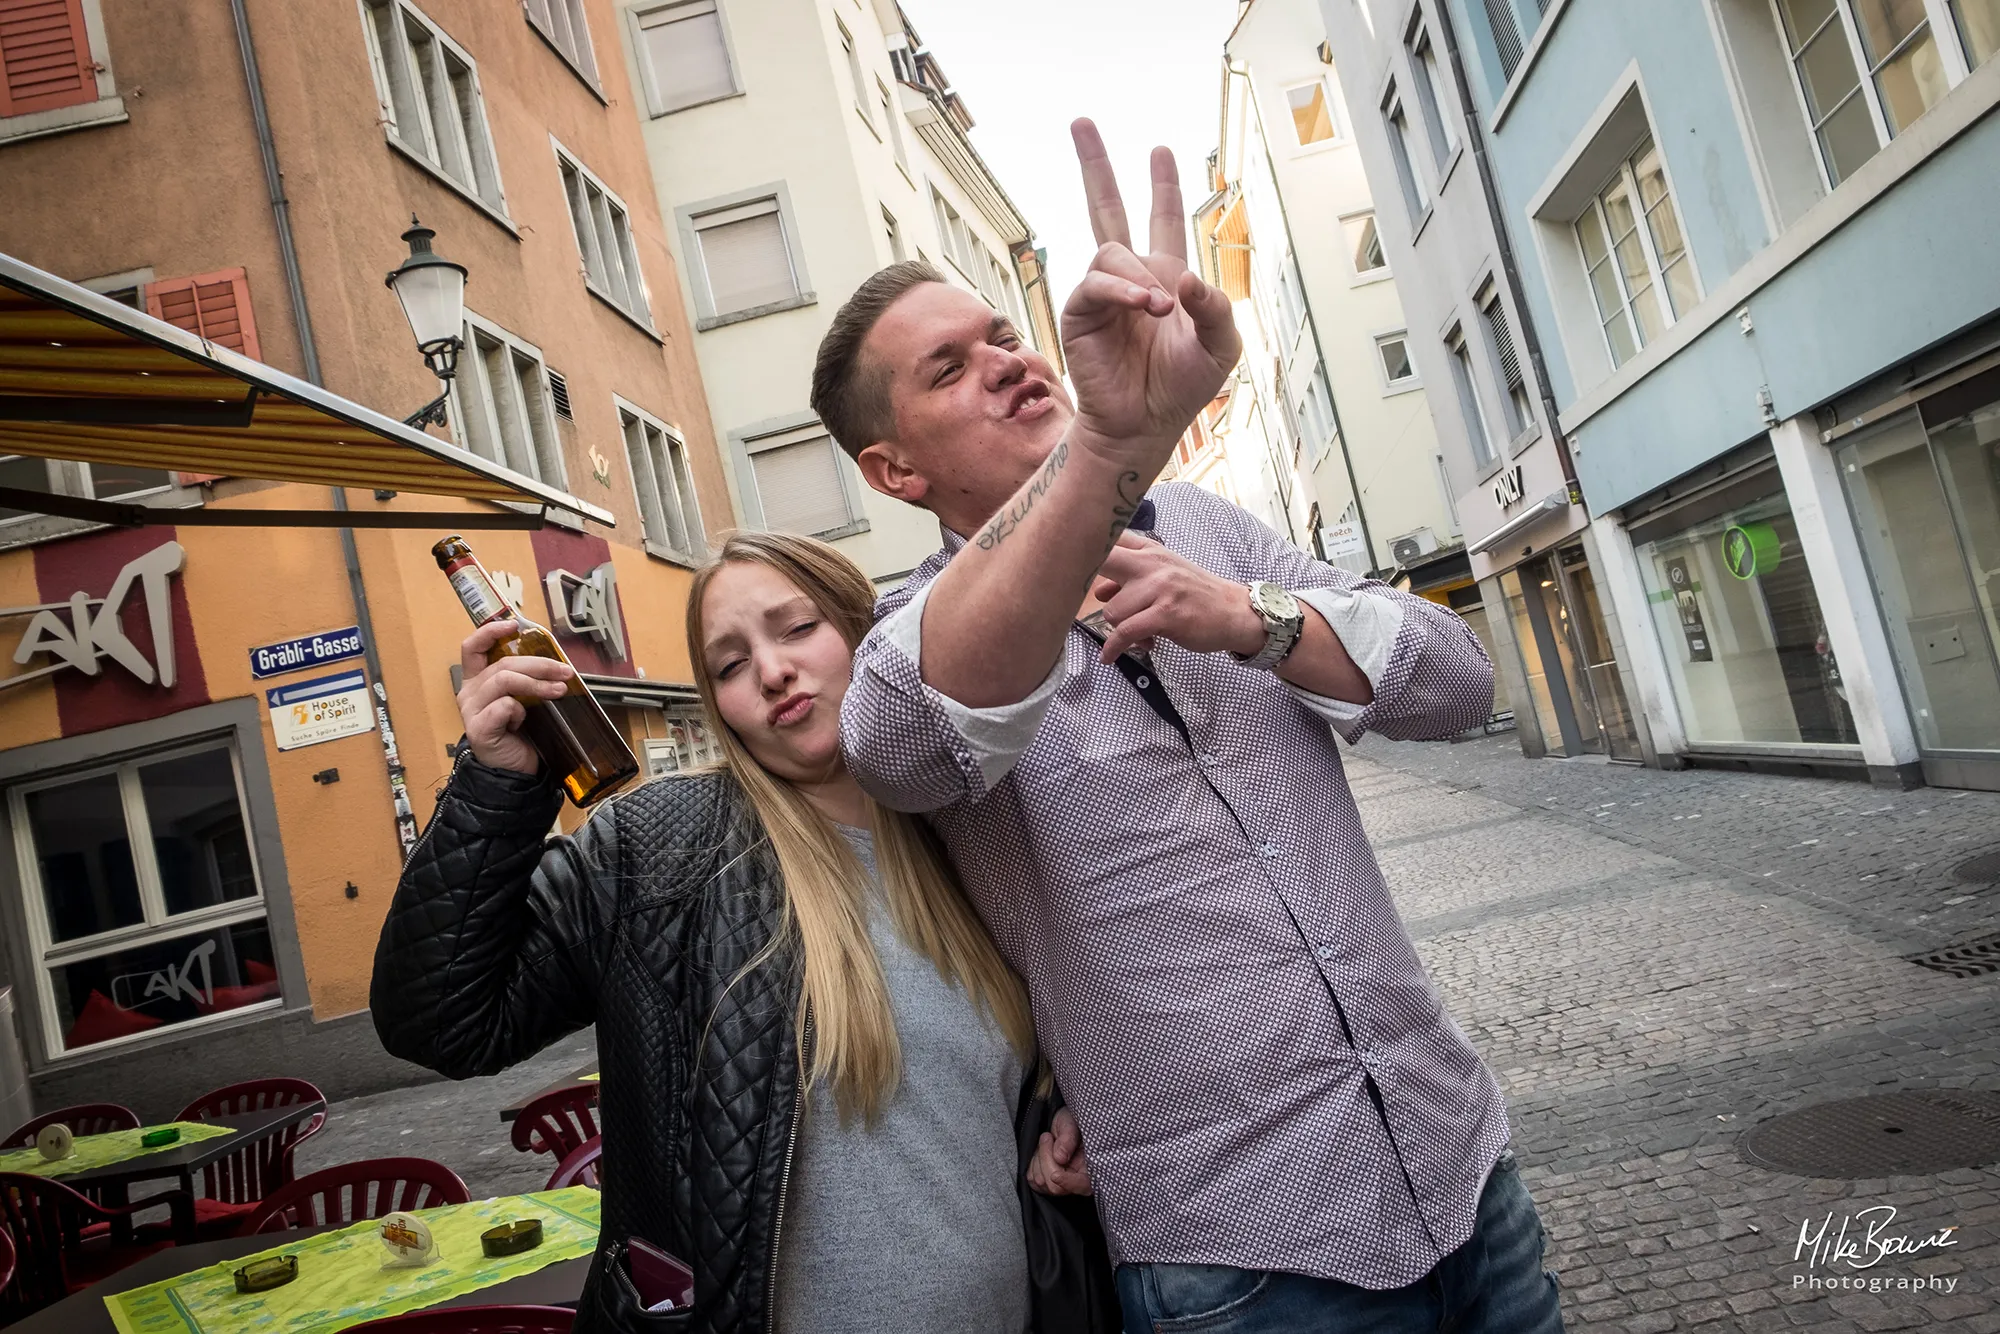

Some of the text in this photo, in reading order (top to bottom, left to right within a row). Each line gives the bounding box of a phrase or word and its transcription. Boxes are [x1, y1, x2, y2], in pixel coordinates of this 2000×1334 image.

[1493, 465, 1525, 510] ONLY
[13, 540, 187, 688] AKT
[258, 635, 360, 670] Gräbli-Gasse
[311, 697, 349, 712] House
[314, 704, 356, 721] of Spirit
[291, 732, 312, 742] Suche
[340, 722, 359, 733] Finde
[144, 939, 216, 1005] AKT
